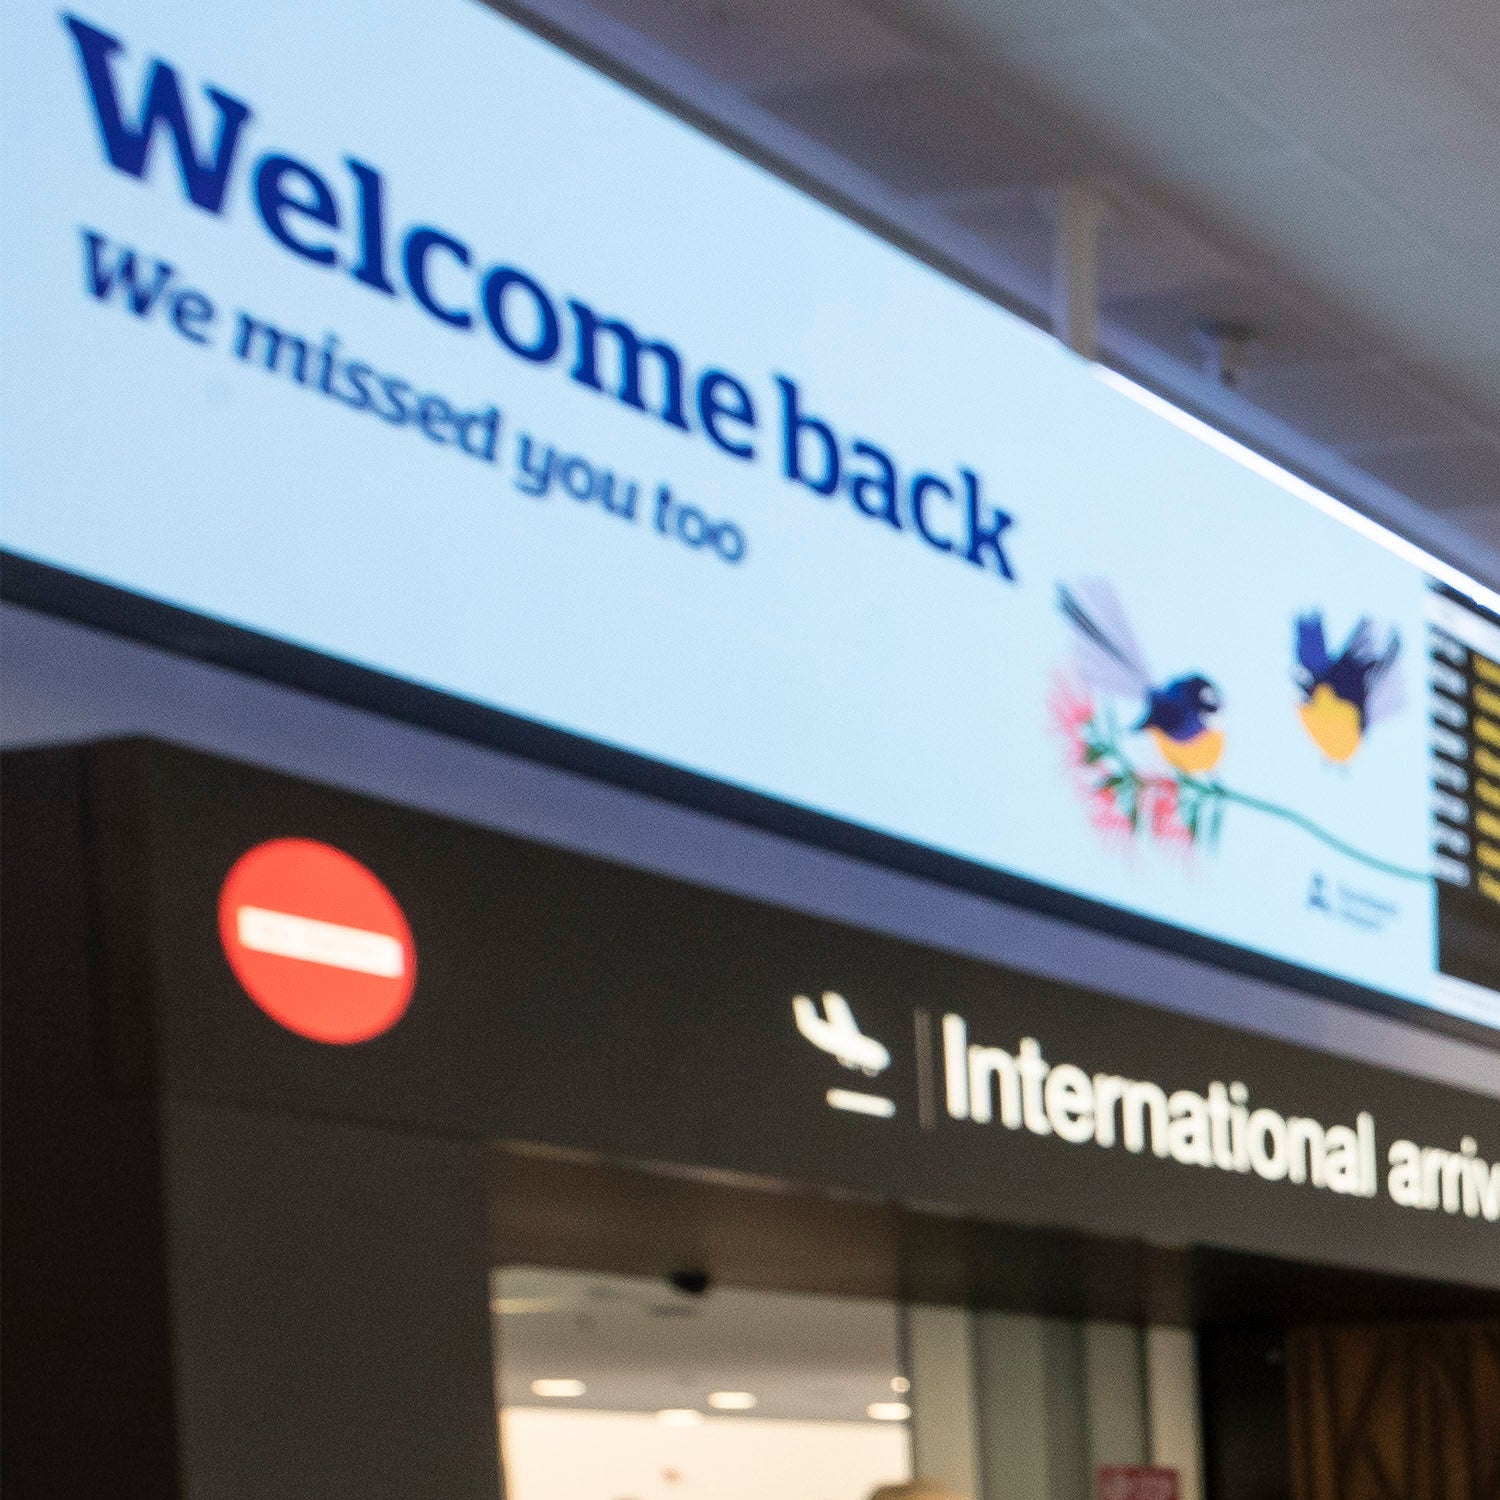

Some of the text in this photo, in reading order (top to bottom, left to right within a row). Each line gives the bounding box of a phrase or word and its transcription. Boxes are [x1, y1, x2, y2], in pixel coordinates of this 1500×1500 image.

[60, 11, 1018, 583] Welcome back
[80, 227, 746, 564] We missed you too
[943, 1013, 1377, 1197] International
